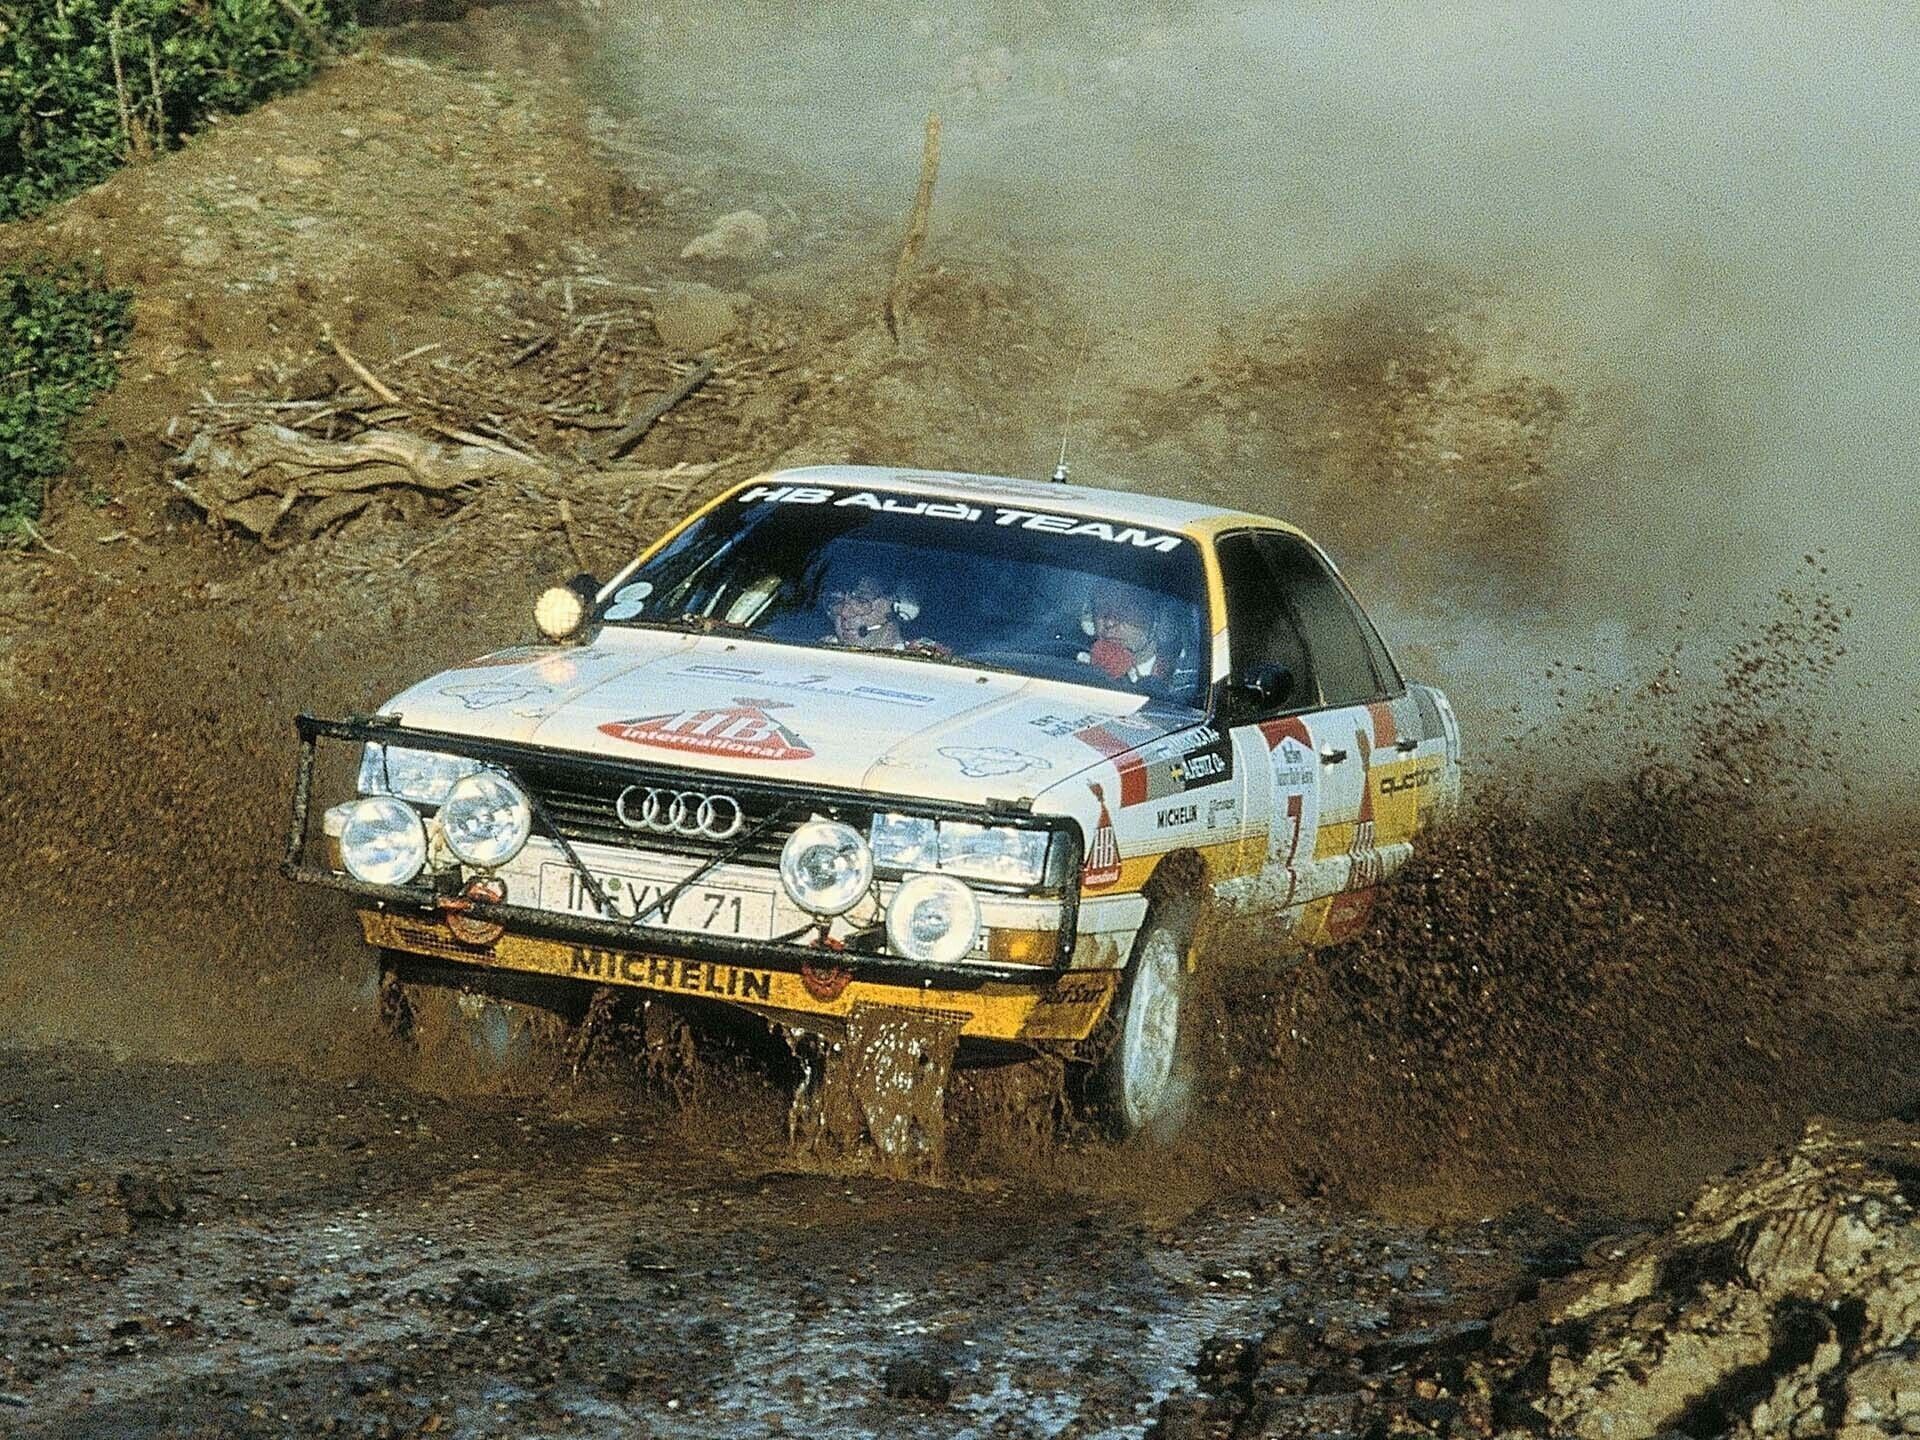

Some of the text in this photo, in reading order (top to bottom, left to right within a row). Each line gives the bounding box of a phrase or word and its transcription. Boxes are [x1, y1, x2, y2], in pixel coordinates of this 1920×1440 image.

[738, 486, 835, 503] HB
[995, 508, 1183, 552] TEAM
[621, 727, 786, 759] International
[661, 710, 773, 742] HB
[1156, 804, 1198, 829] MICHELIN
[704, 893, 742, 934] 71
[569, 946, 773, 1000] MICHELIN
